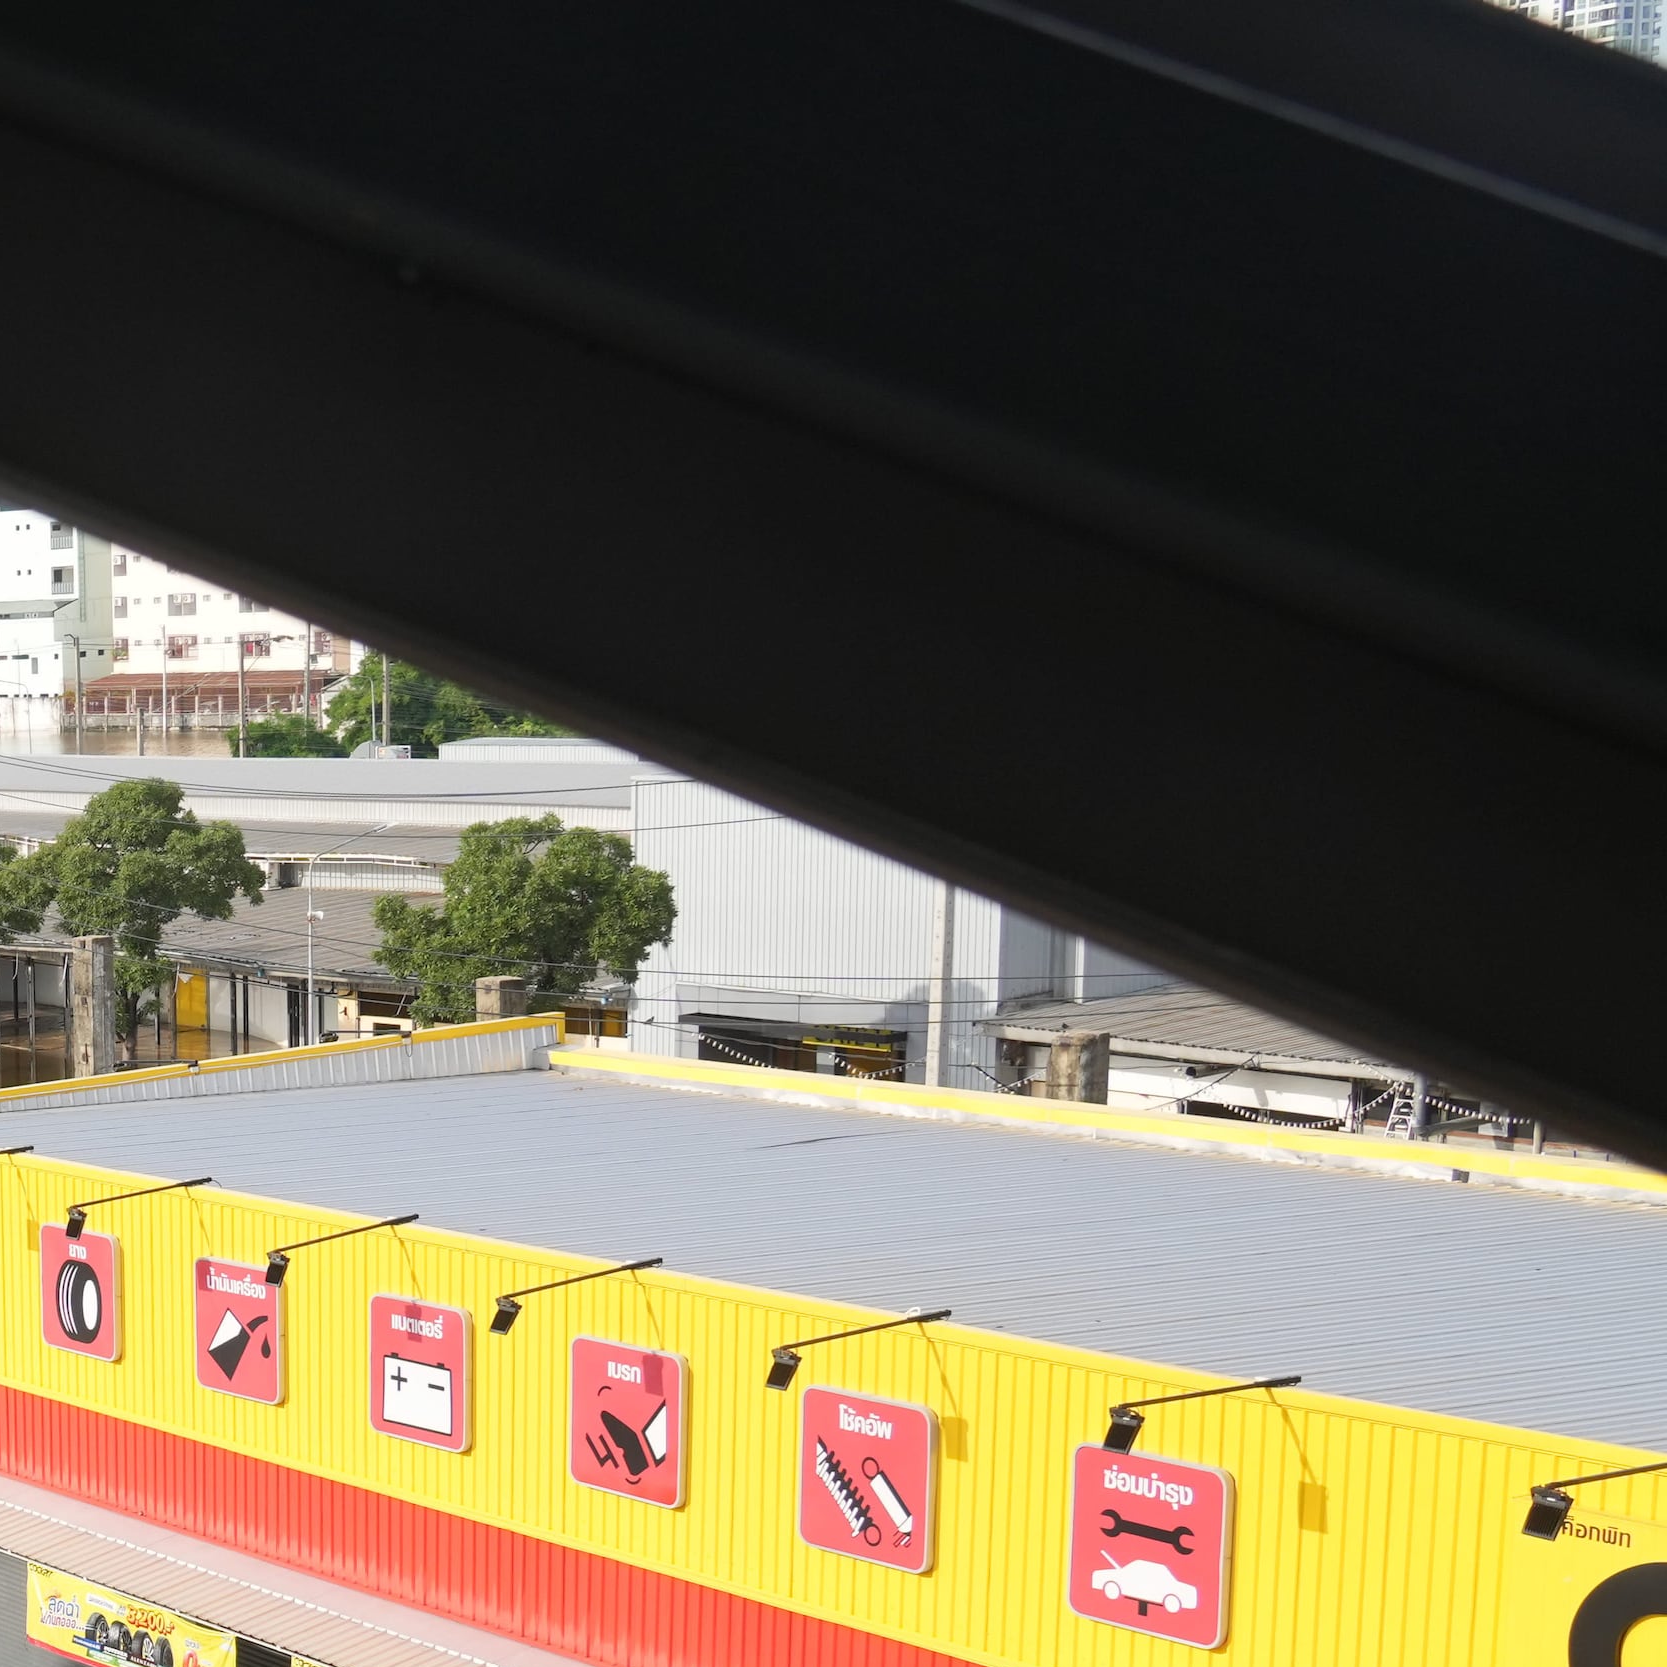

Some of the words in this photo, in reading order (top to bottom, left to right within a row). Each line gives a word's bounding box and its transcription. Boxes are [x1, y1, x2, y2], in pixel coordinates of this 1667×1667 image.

[68, 1243, 87, 1260] ยาง
[206, 1266, 266, 1300] น้ำมันเครื่อง
[391, 1313, 443, 1340] แบตเตอรี่
[607, 1361, 642, 1385] เบรก
[838, 1403, 893, 1441] โช้คอัพ
[1102, 1465, 1194, 1512] ซ่อมบำรุง
